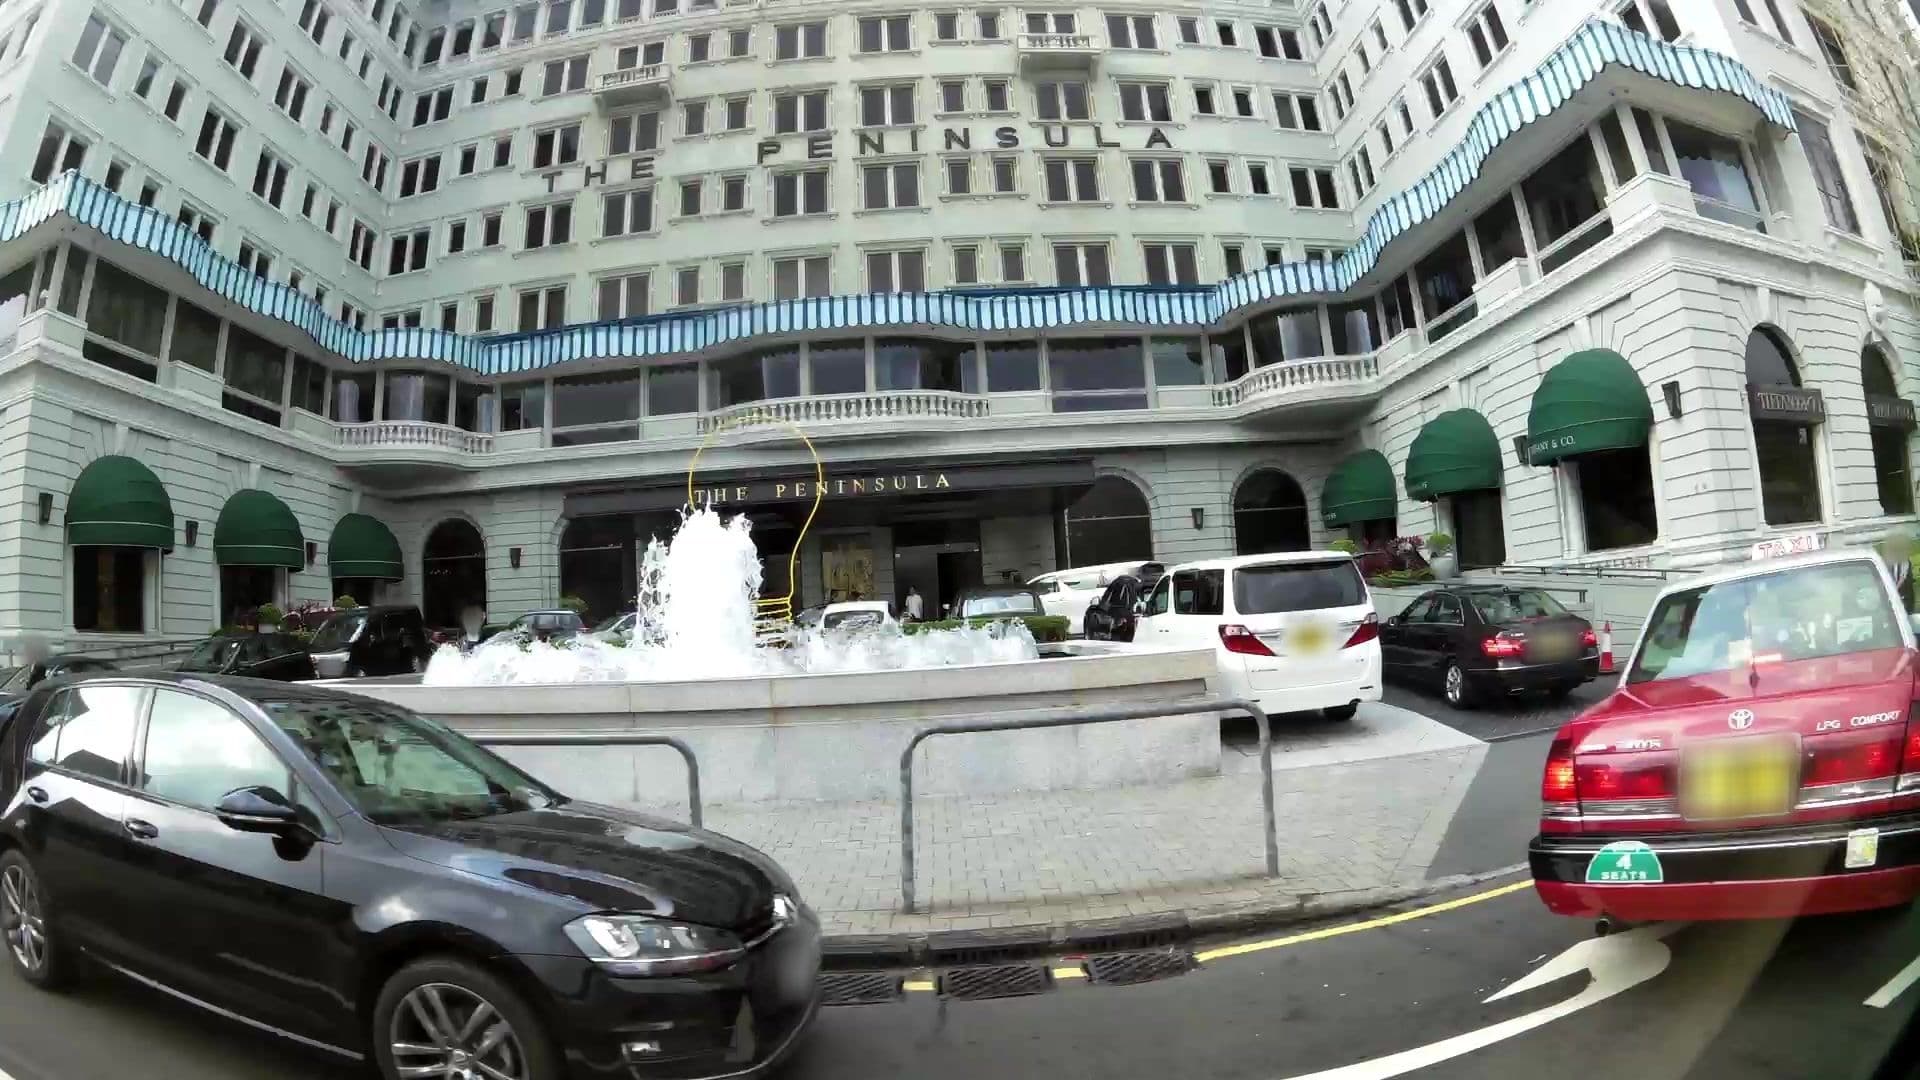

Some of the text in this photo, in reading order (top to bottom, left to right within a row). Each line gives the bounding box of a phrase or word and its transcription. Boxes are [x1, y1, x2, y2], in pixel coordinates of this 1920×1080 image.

[542, 125, 1173, 193] THE PENINSULA
[694, 473, 951, 504] THE PENINSULA
[1759, 535, 1813, 559] TAXI
[1816, 710, 1902, 731] LPG COMFORT
[1616, 854, 1633, 870] 4
[1601, 870, 1647, 880] SEATS
